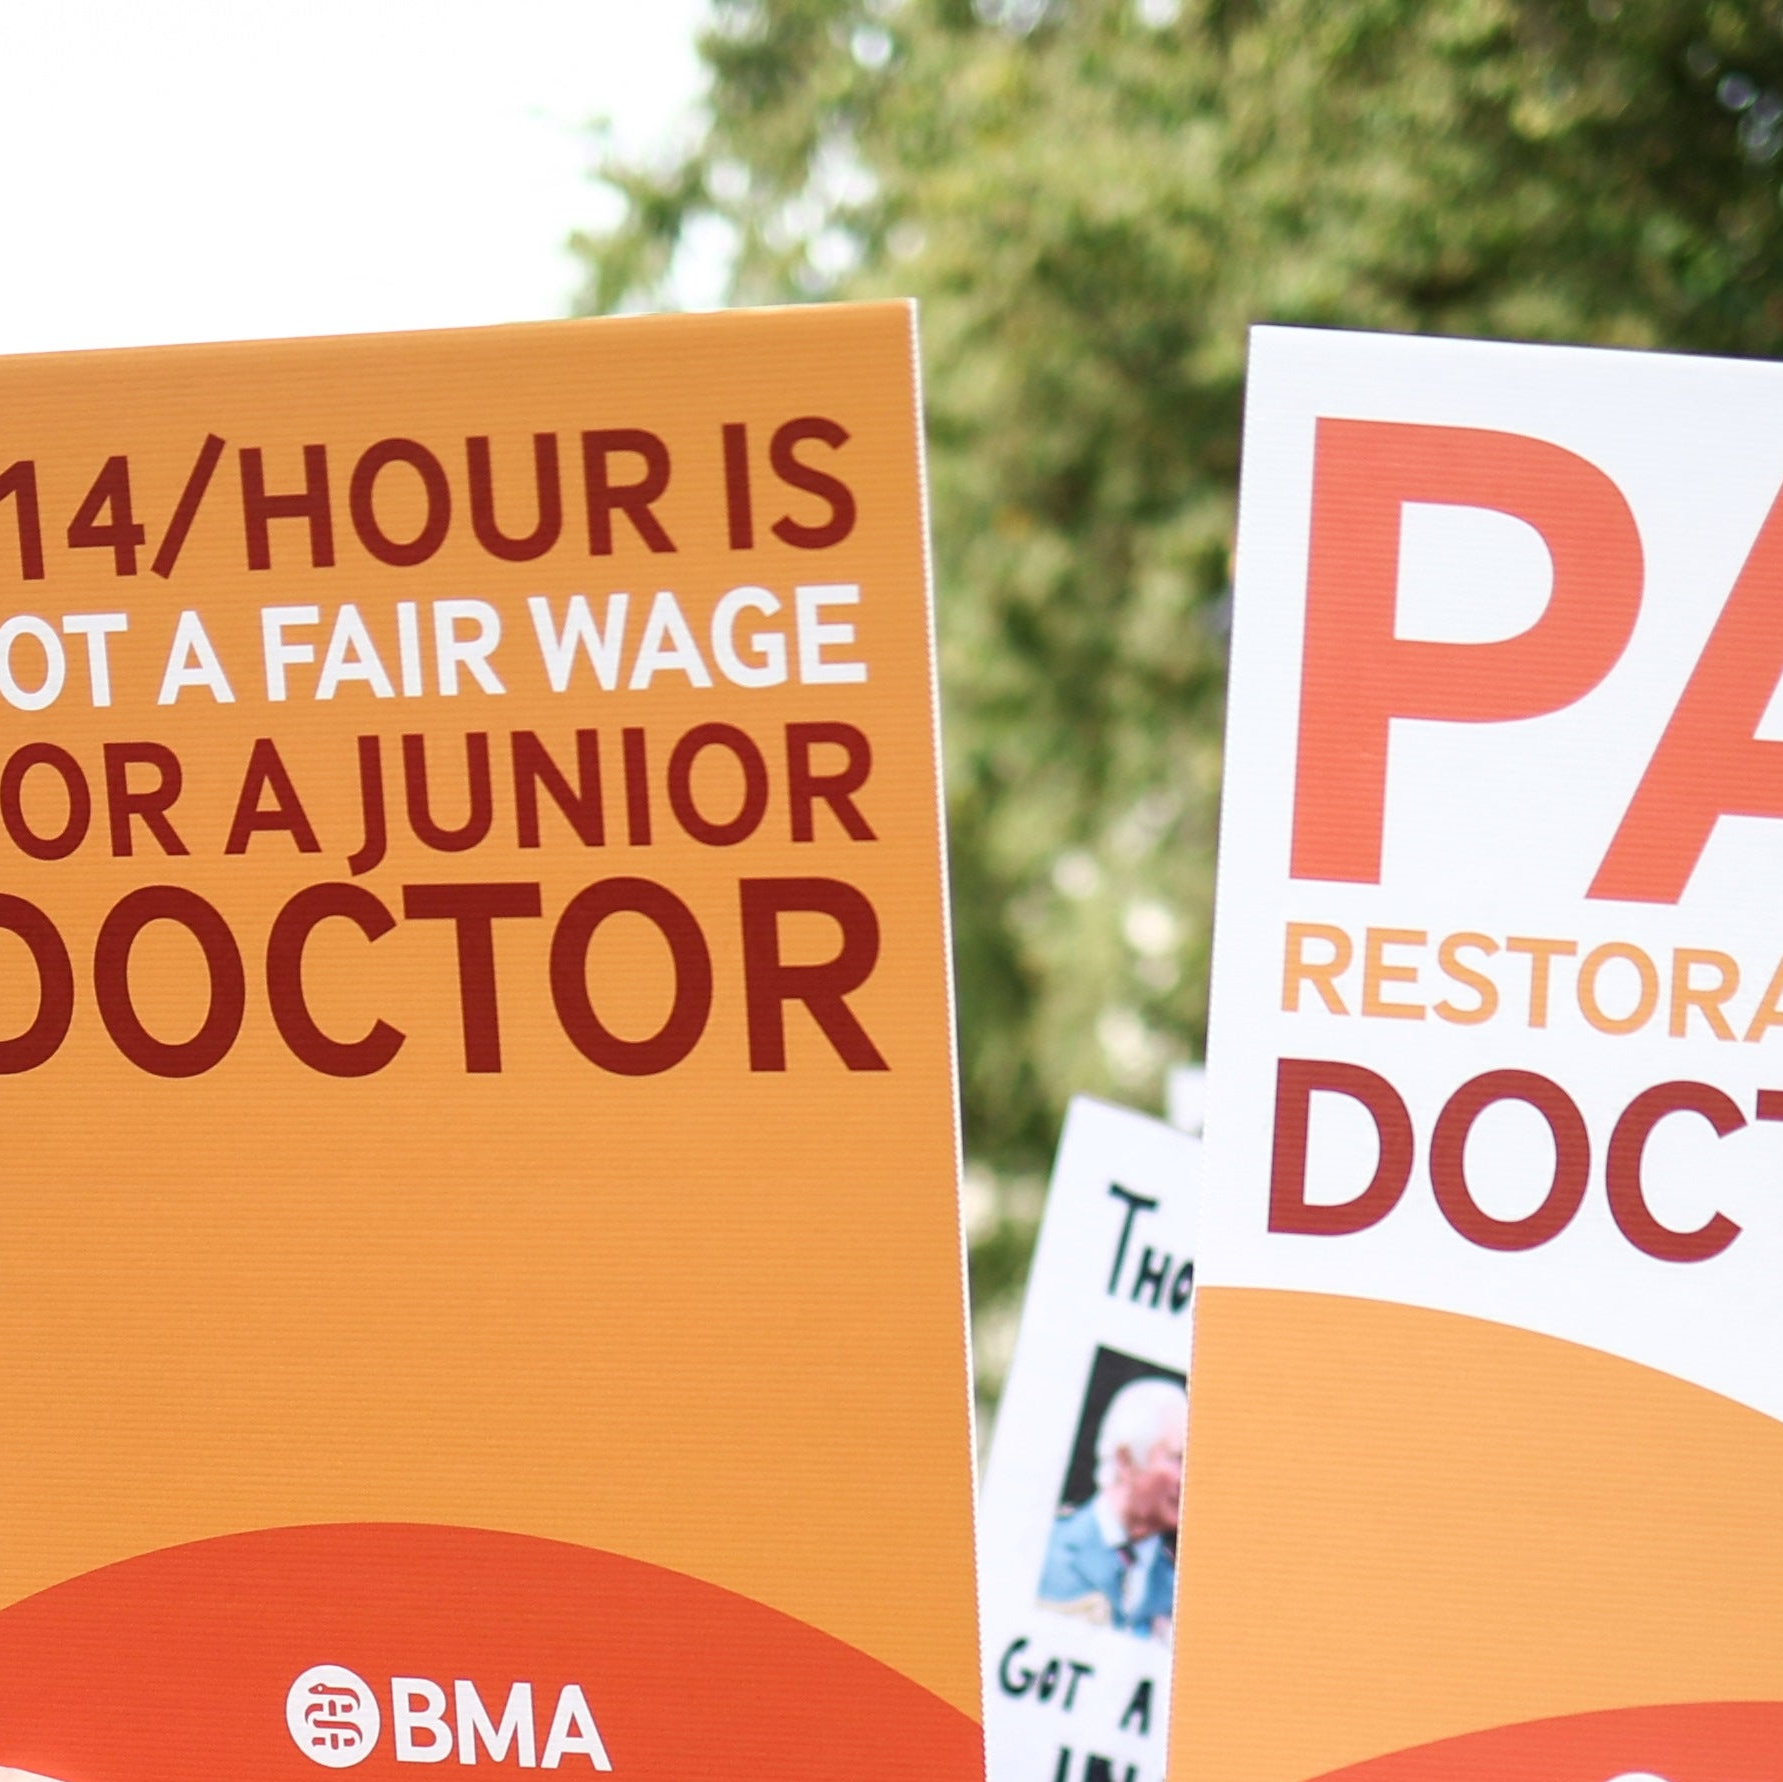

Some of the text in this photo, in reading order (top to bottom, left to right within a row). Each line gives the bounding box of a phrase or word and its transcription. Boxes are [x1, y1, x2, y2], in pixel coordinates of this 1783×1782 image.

[721, 415, 858, 552] IS
[156, 610, 236, 707] A
[260, 597, 507, 703] FAIR
[526, 584, 868, 693] WAGE
[224, 737, 323, 856] A
[345, 720, 880, 877] JUNIOR
[391, 1676, 613, 1772] BMA
[998, 1636, 1154, 1736] GOT A
